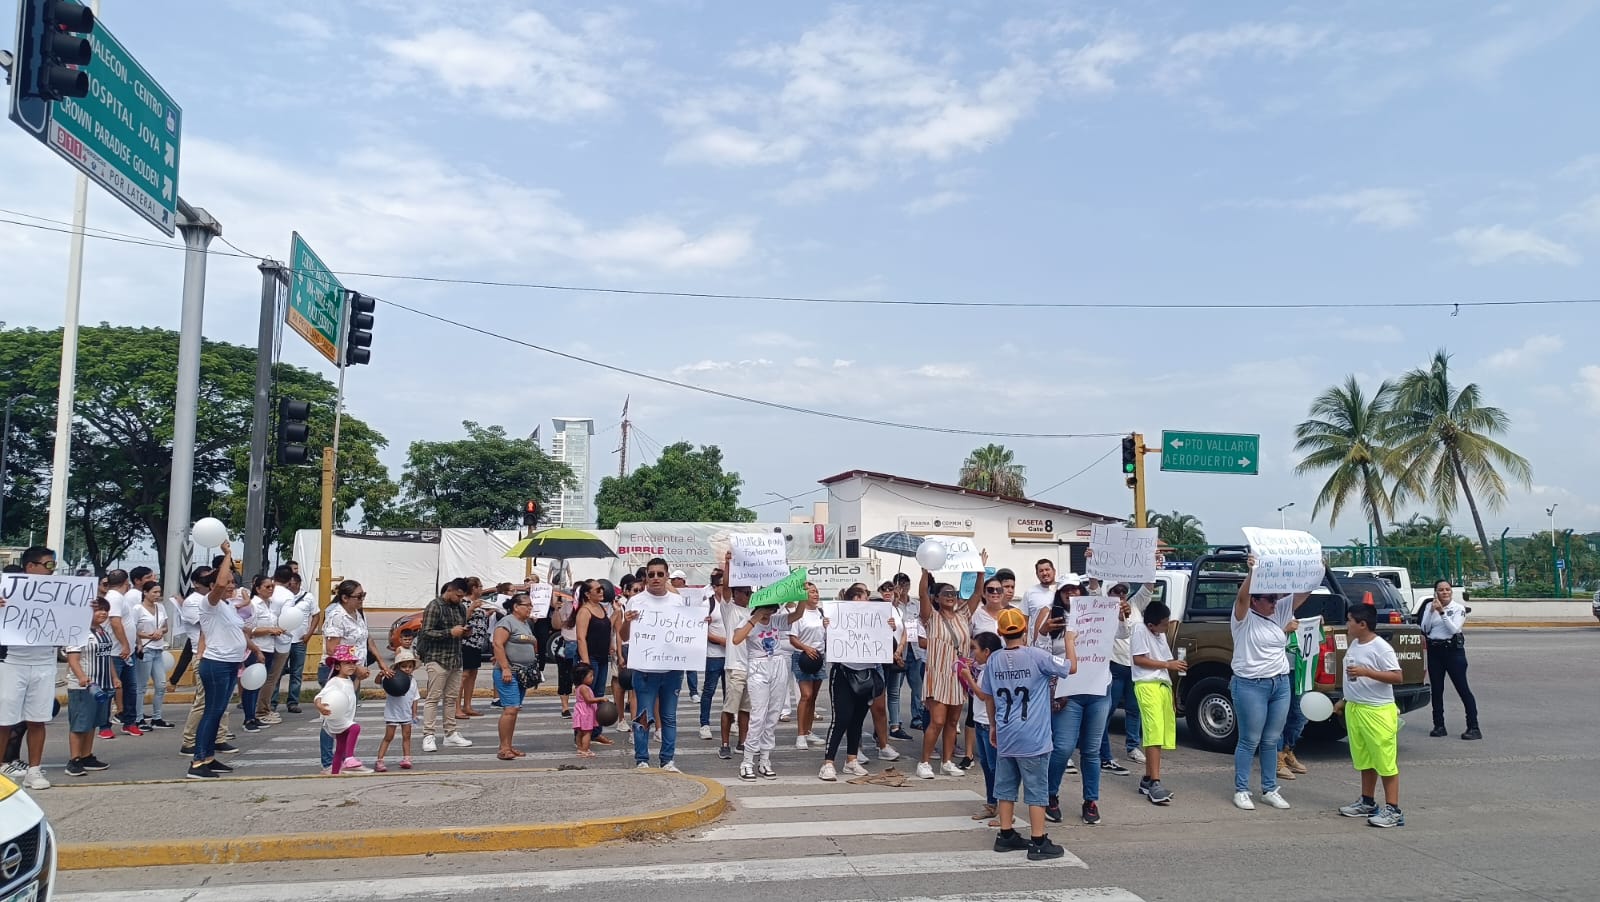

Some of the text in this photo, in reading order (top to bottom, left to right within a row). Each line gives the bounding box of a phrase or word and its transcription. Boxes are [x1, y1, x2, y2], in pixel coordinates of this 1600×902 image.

[134, 80, 163, 119] CENTRO
[138, 122, 161, 154] JOYA
[94, 121, 131, 165] PARADISE
[133, 151, 159, 189] GOLDEN
[58, 130, 82, 157] 911
[109, 169, 124, 192] POR
[127, 183, 156, 215] LATERAL
[1184, 438, 1255, 452] PTO VALLARTA
[1163, 453, 1234, 467] AEROPUERTO
[1045, 519, 1053, 533] 8
[630, 533, 696, 543] Encuentra el
[667, 547, 683, 555] tea
[686, 546, 709, 556] más
[1088, 550, 1151, 568] NOS UNE
[3, 576, 95, 607] JUSTICIA
[3, 605, 57, 630] PARA
[830, 602, 882, 630] JUSTICIA
[26, 626, 82, 645] OMAR
[634, 630, 697, 645] para Omar
[848, 630, 870, 641] PARA
[1400, 634, 1421, 645] PT-273
[833, 639, 887, 659] OMAR
[1303, 633, 1312, 658] 10
